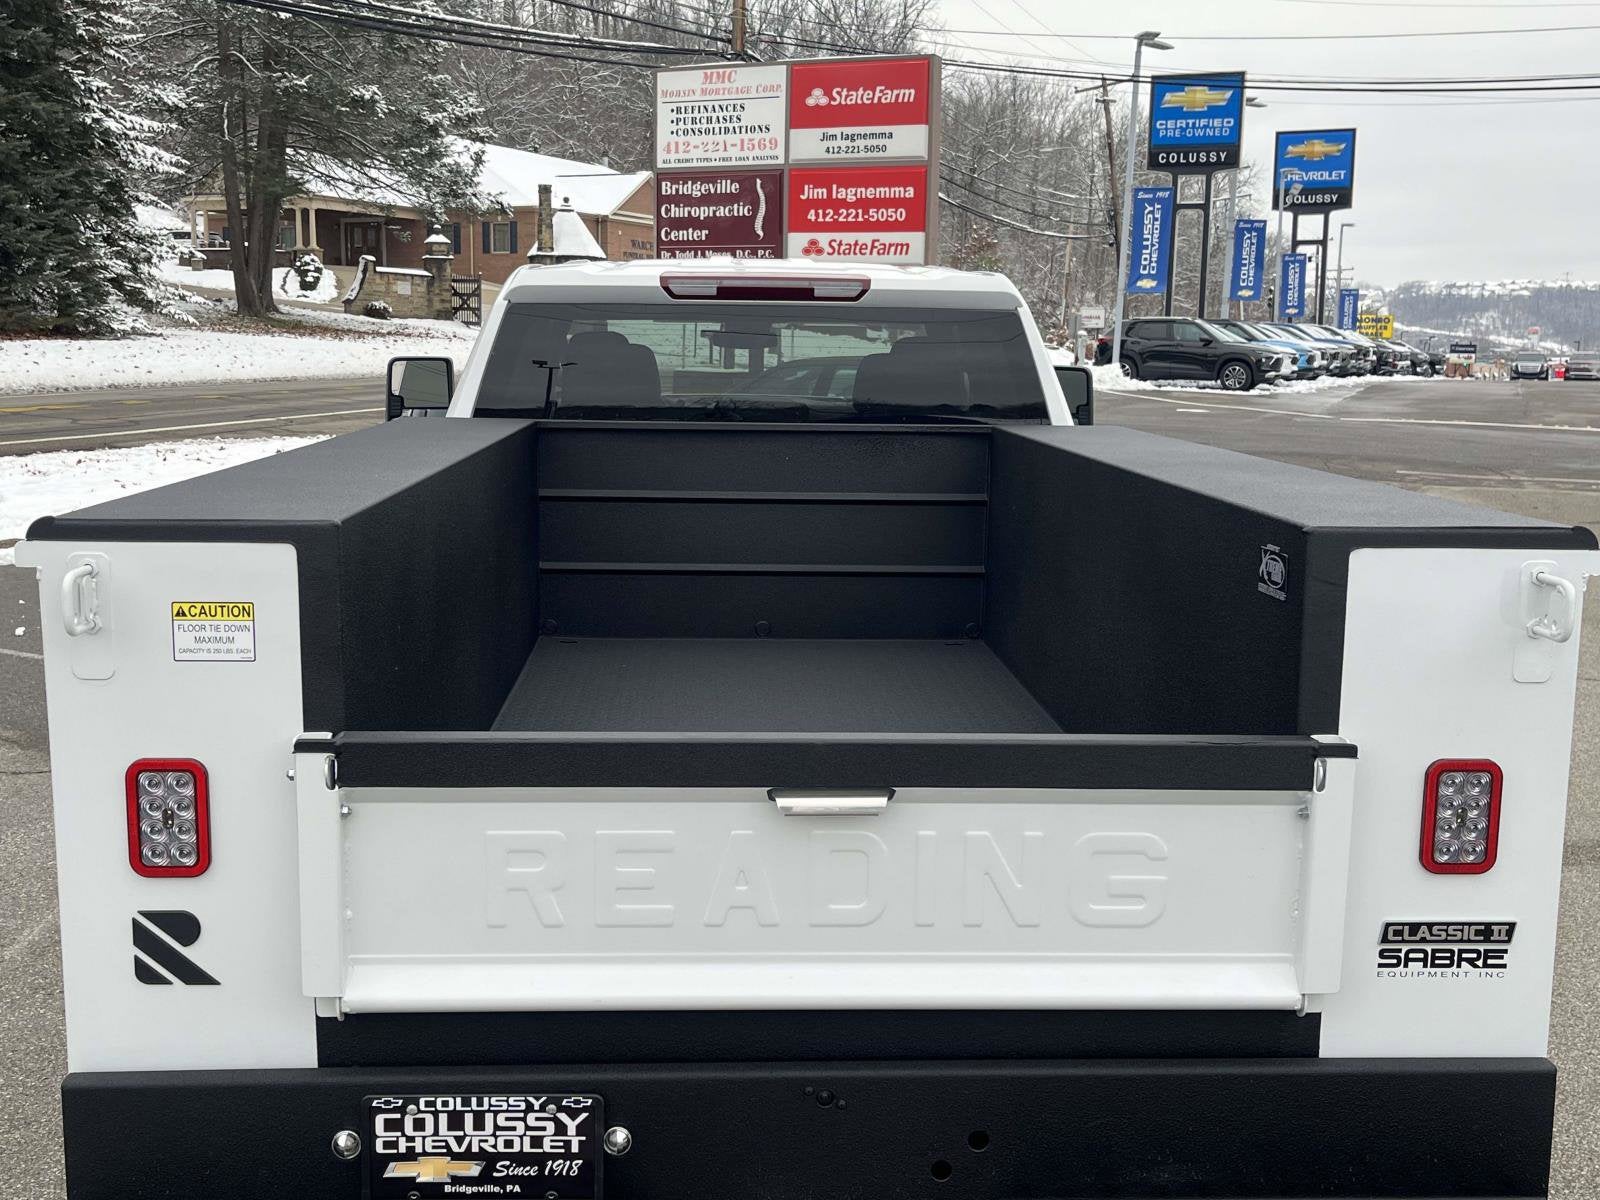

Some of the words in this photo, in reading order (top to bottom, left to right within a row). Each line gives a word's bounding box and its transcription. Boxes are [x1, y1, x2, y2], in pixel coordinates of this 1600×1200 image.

[701, 70, 737, 85] MMC
[700, 86, 752, 96] MORTGAGE
[755, 84, 783, 93] CORP.
[675, 103, 746, 115] REFINANCES
[675, 114, 742, 126] PURCHASES
[1156, 117, 1234, 129] CERTIFIED
[675, 124, 771, 137] CONSOLIDATIONS
[819, 131, 838, 142] Jim
[840, 130, 894, 143] Iagnemma
[1159, 127, 1230, 138] PRE-OWNED
[662, 137, 778, 155] 412-221-1569
[824, 144, 887, 154] 412-221-5050
[1158, 151, 1227, 164] COLUSSY
[1283, 170, 1347, 182] HEVROLET
[660, 179, 740, 198] Bridgeville
[799, 184, 827, 200] Jim
[831, 183, 914, 202] Iagnemma
[660, 202, 753, 220] Chiropractic
[806, 208, 906, 222] 412-221-5050
[660, 227, 709, 241] Center
[1139, 202, 1154, 275] COLUSSY
[1149, 202, 1162, 275] CHEVROLET
[757, 249, 775, 259] P.C.
[1239, 230, 1252, 287] COLUSSY
[1247, 230, 1258, 287] CHEVROLET
[188, 604, 251, 618] CAUTION
[177, 624, 207, 633] FLOOR
[209, 624, 222, 633] TIE
[223, 624, 251, 633] DOWN
[194, 636, 235, 645] MAXIMUM
[485, 829, 1169, 929] READING
[1387, 925, 1485, 941] CLASSIC
[1490, 925, 1510, 941] II
[1376, 947, 1509, 969] SABRE
[1376, 970, 1471, 978] EQUIPMENT
[1478, 970, 1505, 979] INC
[419, 1096, 548, 1111] COLUSSY
[374, 1112, 590, 1137] COLUSSY
[375, 1136, 587, 1154] CHEVROLET
[492, 1160, 539, 1178] Since
[543, 1159, 584, 1177] 1918
[444, 1184, 504, 1195] Bridgeville,
[506, 1184, 521, 1194] PA
